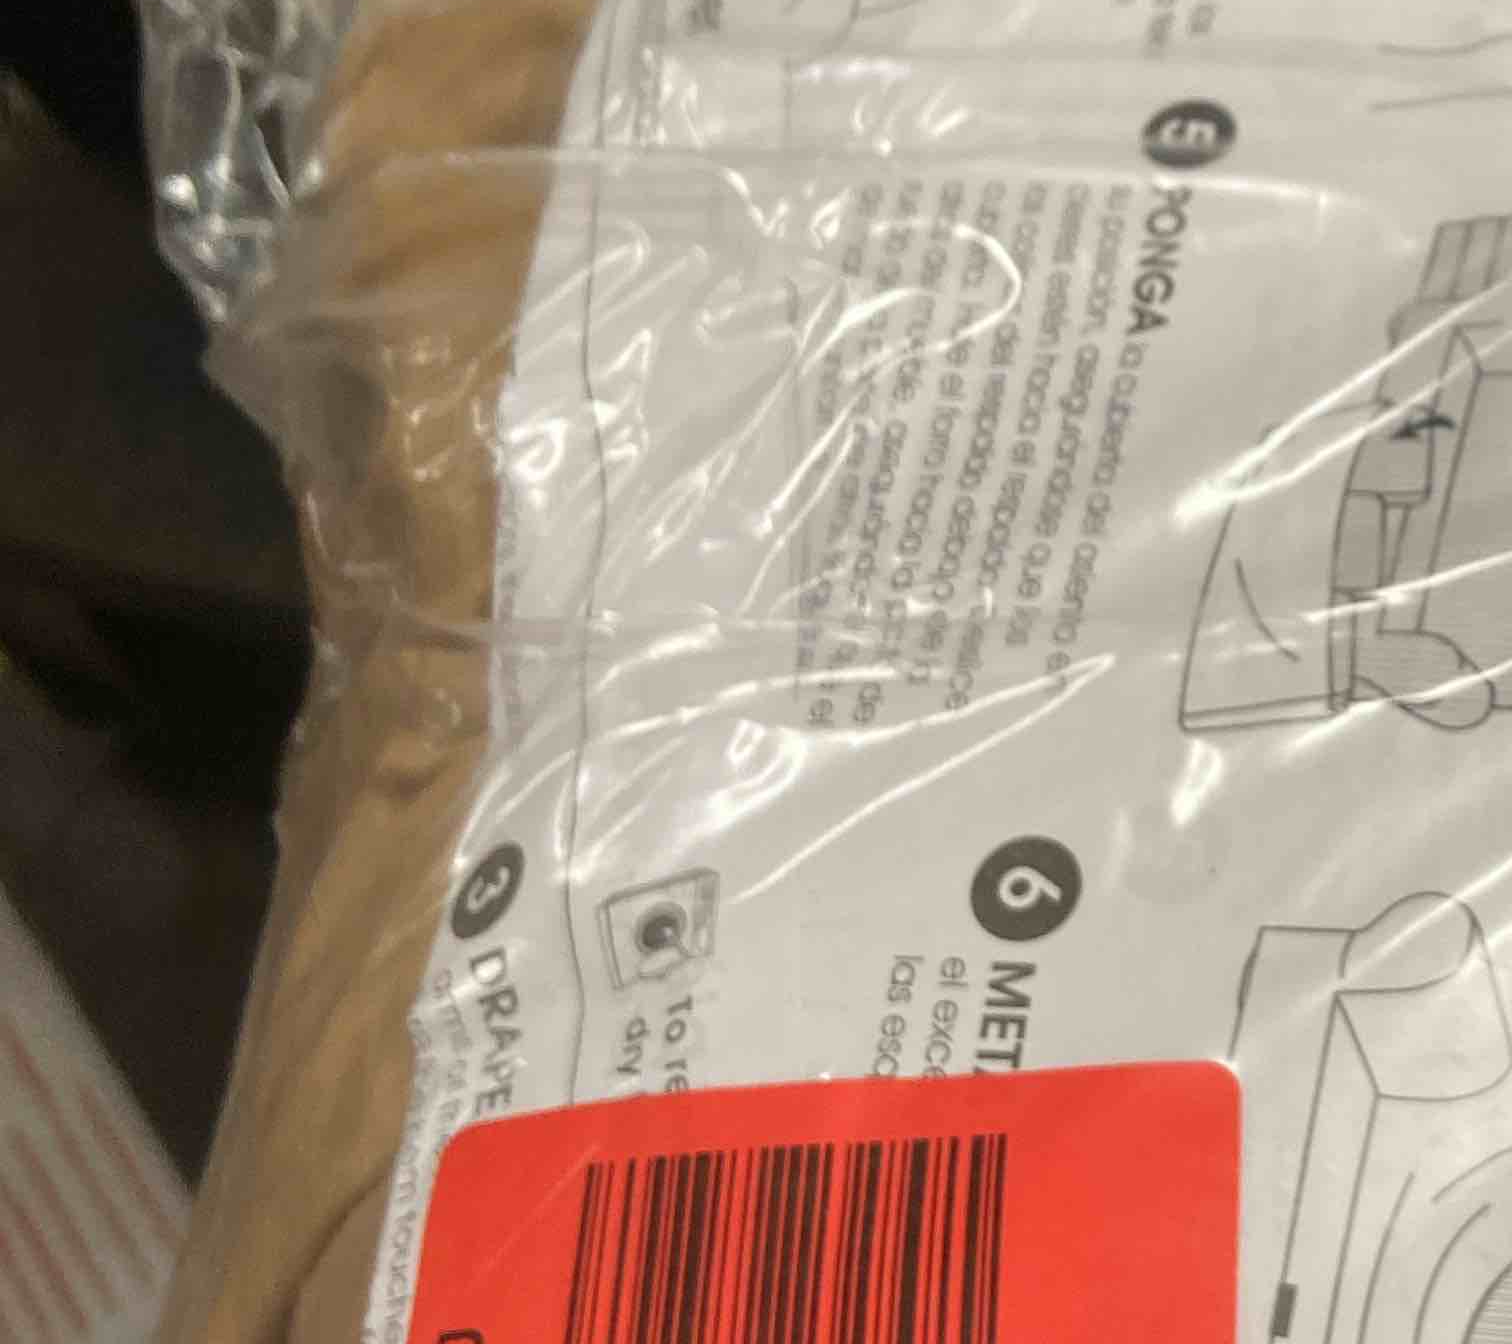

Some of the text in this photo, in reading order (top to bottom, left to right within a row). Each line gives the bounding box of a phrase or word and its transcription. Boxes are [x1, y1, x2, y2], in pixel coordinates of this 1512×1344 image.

[887, 956, 925, 1003] las
[939, 957, 970, 988] el
[665, 995, 694, 1043] To
[974, 961, 1036, 1078] MET
